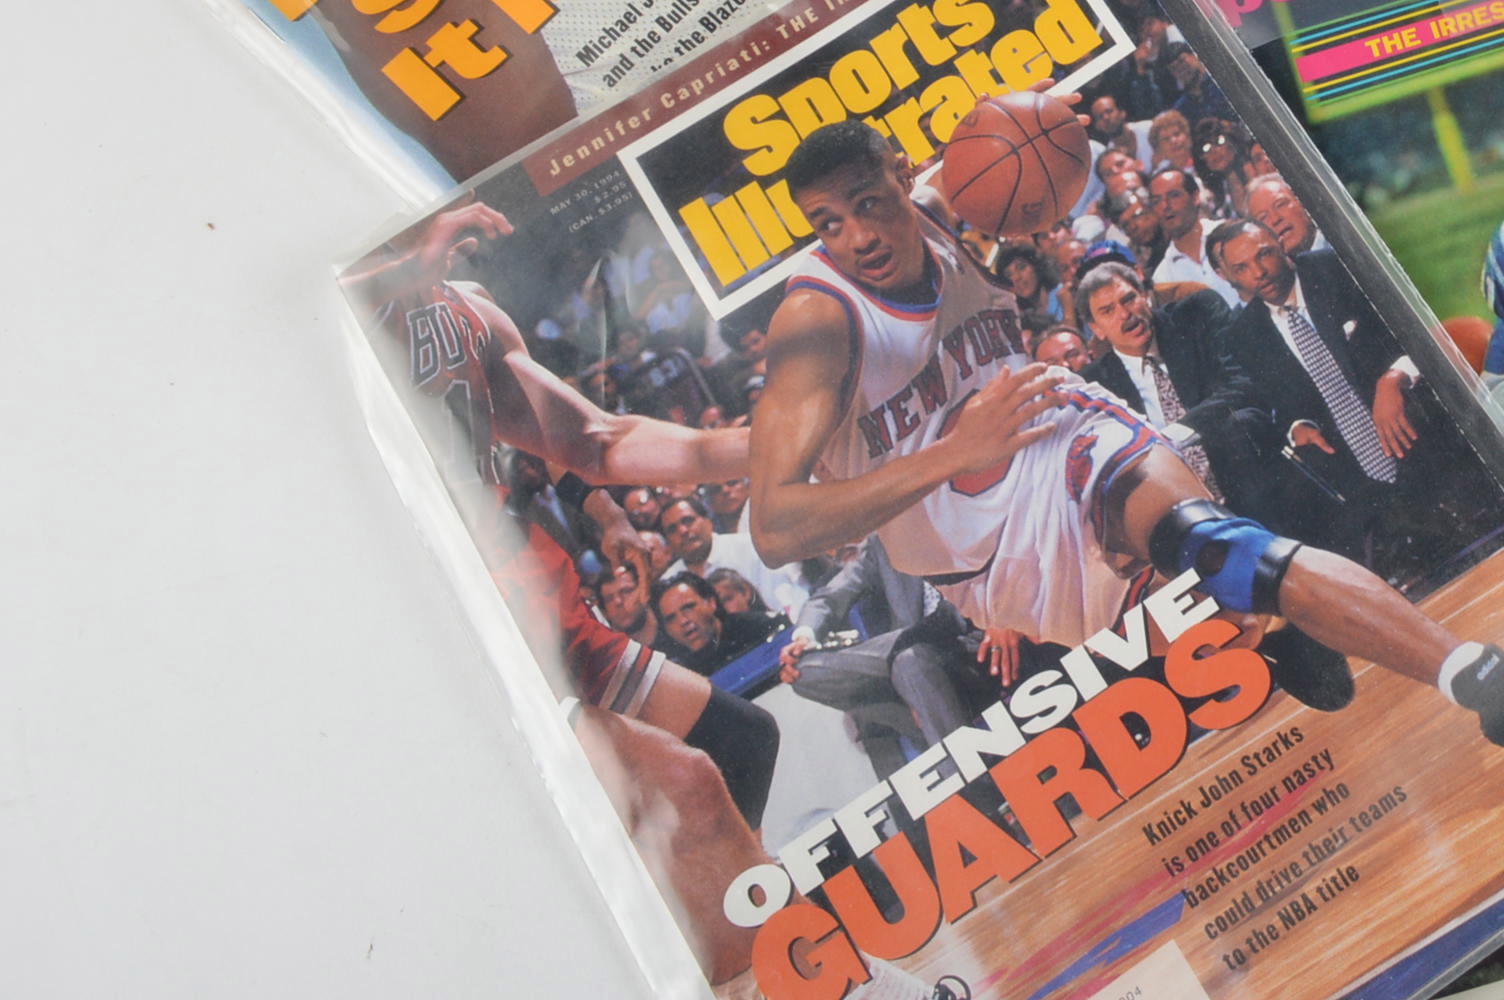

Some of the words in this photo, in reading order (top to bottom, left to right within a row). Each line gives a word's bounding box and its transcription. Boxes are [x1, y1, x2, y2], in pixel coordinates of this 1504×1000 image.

[381, 18, 512, 122] It
[549, 107, 654, 177] Jennifer
[662, 37, 772, 110] Capriati:
[777, 6, 819, 40] THE
[575, 2, 644, 68] Michael
[602, 53, 635, 88] and
[630, 29, 661, 58] the
[674, 30, 706, 57] the
[1365, 27, 1422, 60] THE
[550, 197, 571, 215] MAY
[857, 352, 949, 459] NEW
[941, 308, 1027, 381] YORK
[723, 567, 1222, 928] OFFENSIVE
[1142, 799, 1198, 847] Knick
[1198, 768, 1244, 809] John
[1240, 725, 1305, 777] Starks
[751, 618, 1273, 1000] GUARDS
[1161, 856, 1186, 878] is
[1186, 830, 1220, 864] one
[1220, 811, 1243, 838] of
[1241, 785, 1282, 823] four
[1281, 747, 1336, 796] nasty
[1181, 808, 1314, 910] backcourtmen
[1311, 781, 1351, 817] who
[1203, 891, 1258, 941] could
[1257, 860, 1305, 904] drive
[1302, 824, 1350, 869] their
[1348, 783, 1408, 835] teams
[1222, 948, 1248, 972] to
[1245, 922, 1281, 955] the
[1277, 891, 1319, 931] NBA
[1315, 863, 1361, 904] title
